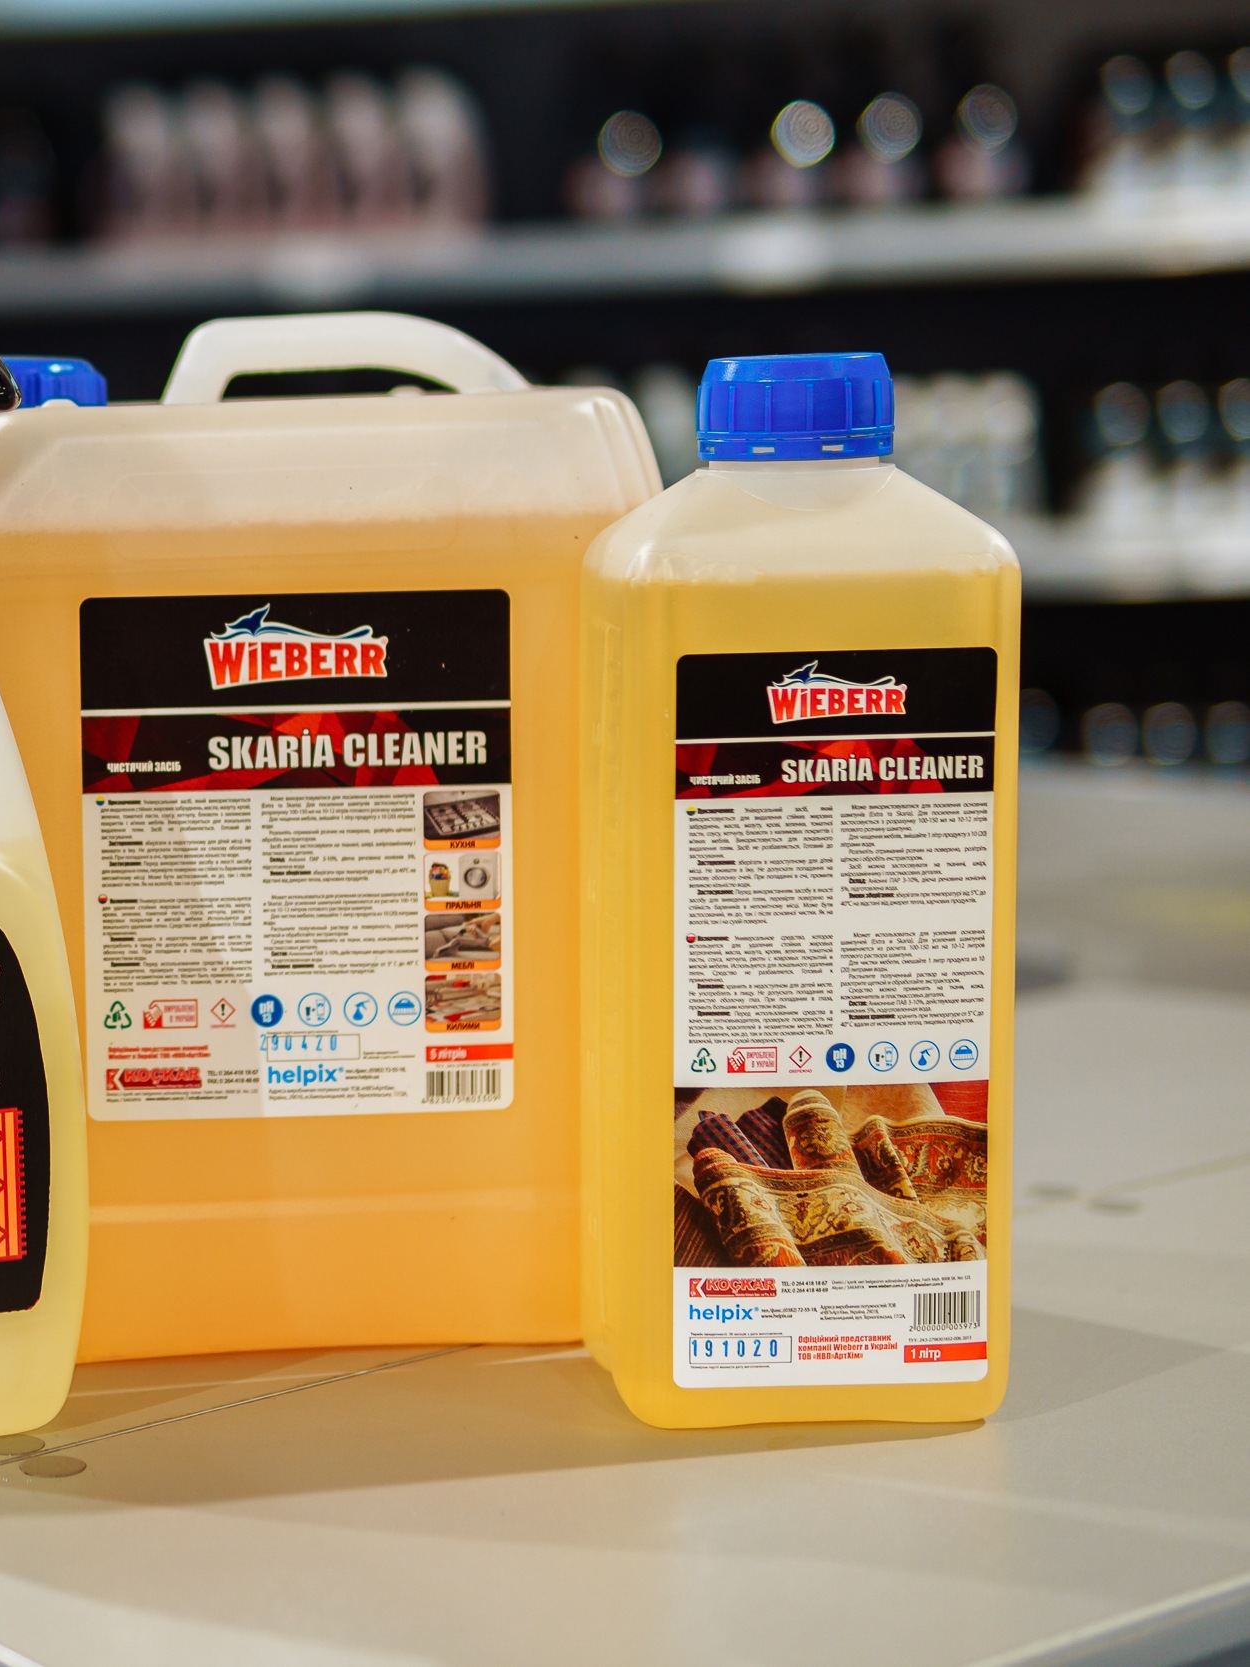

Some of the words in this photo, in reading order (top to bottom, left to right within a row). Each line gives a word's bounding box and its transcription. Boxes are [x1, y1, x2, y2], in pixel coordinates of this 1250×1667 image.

[343, 731, 487, 767] CLEANER
[155, 761, 181, 772] ЗАСІБ
[879, 755, 984, 781] CLEANER
[735, 775, 761, 785] ЗАСІБ
[450, 840, 475, 849] КУХНЯ
[446, 901, 481, 910] ПРАЛЬНЯ
[451, 962, 475, 970] МЕБЛІ
[430, 1048, 437, 1060] 5
[746, 1051, 775, 1059] ВИРОБЛЕНО
[833, 1048, 848, 1061] pH
[836, 1059, 845, 1068] 13
[706, 1278, 776, 1294] KOÇKAR
[798, 1334, 839, 1344] Офіційний
[840, 1334, 891, 1343] представник
[798, 1344, 832, 1352] компанії
[833, 1343, 863, 1351] Wieberr
[870, 1342, 897, 1350] Україні
[911, 1348, 916, 1359] 1
[918, 1347, 941, 1361] літр
